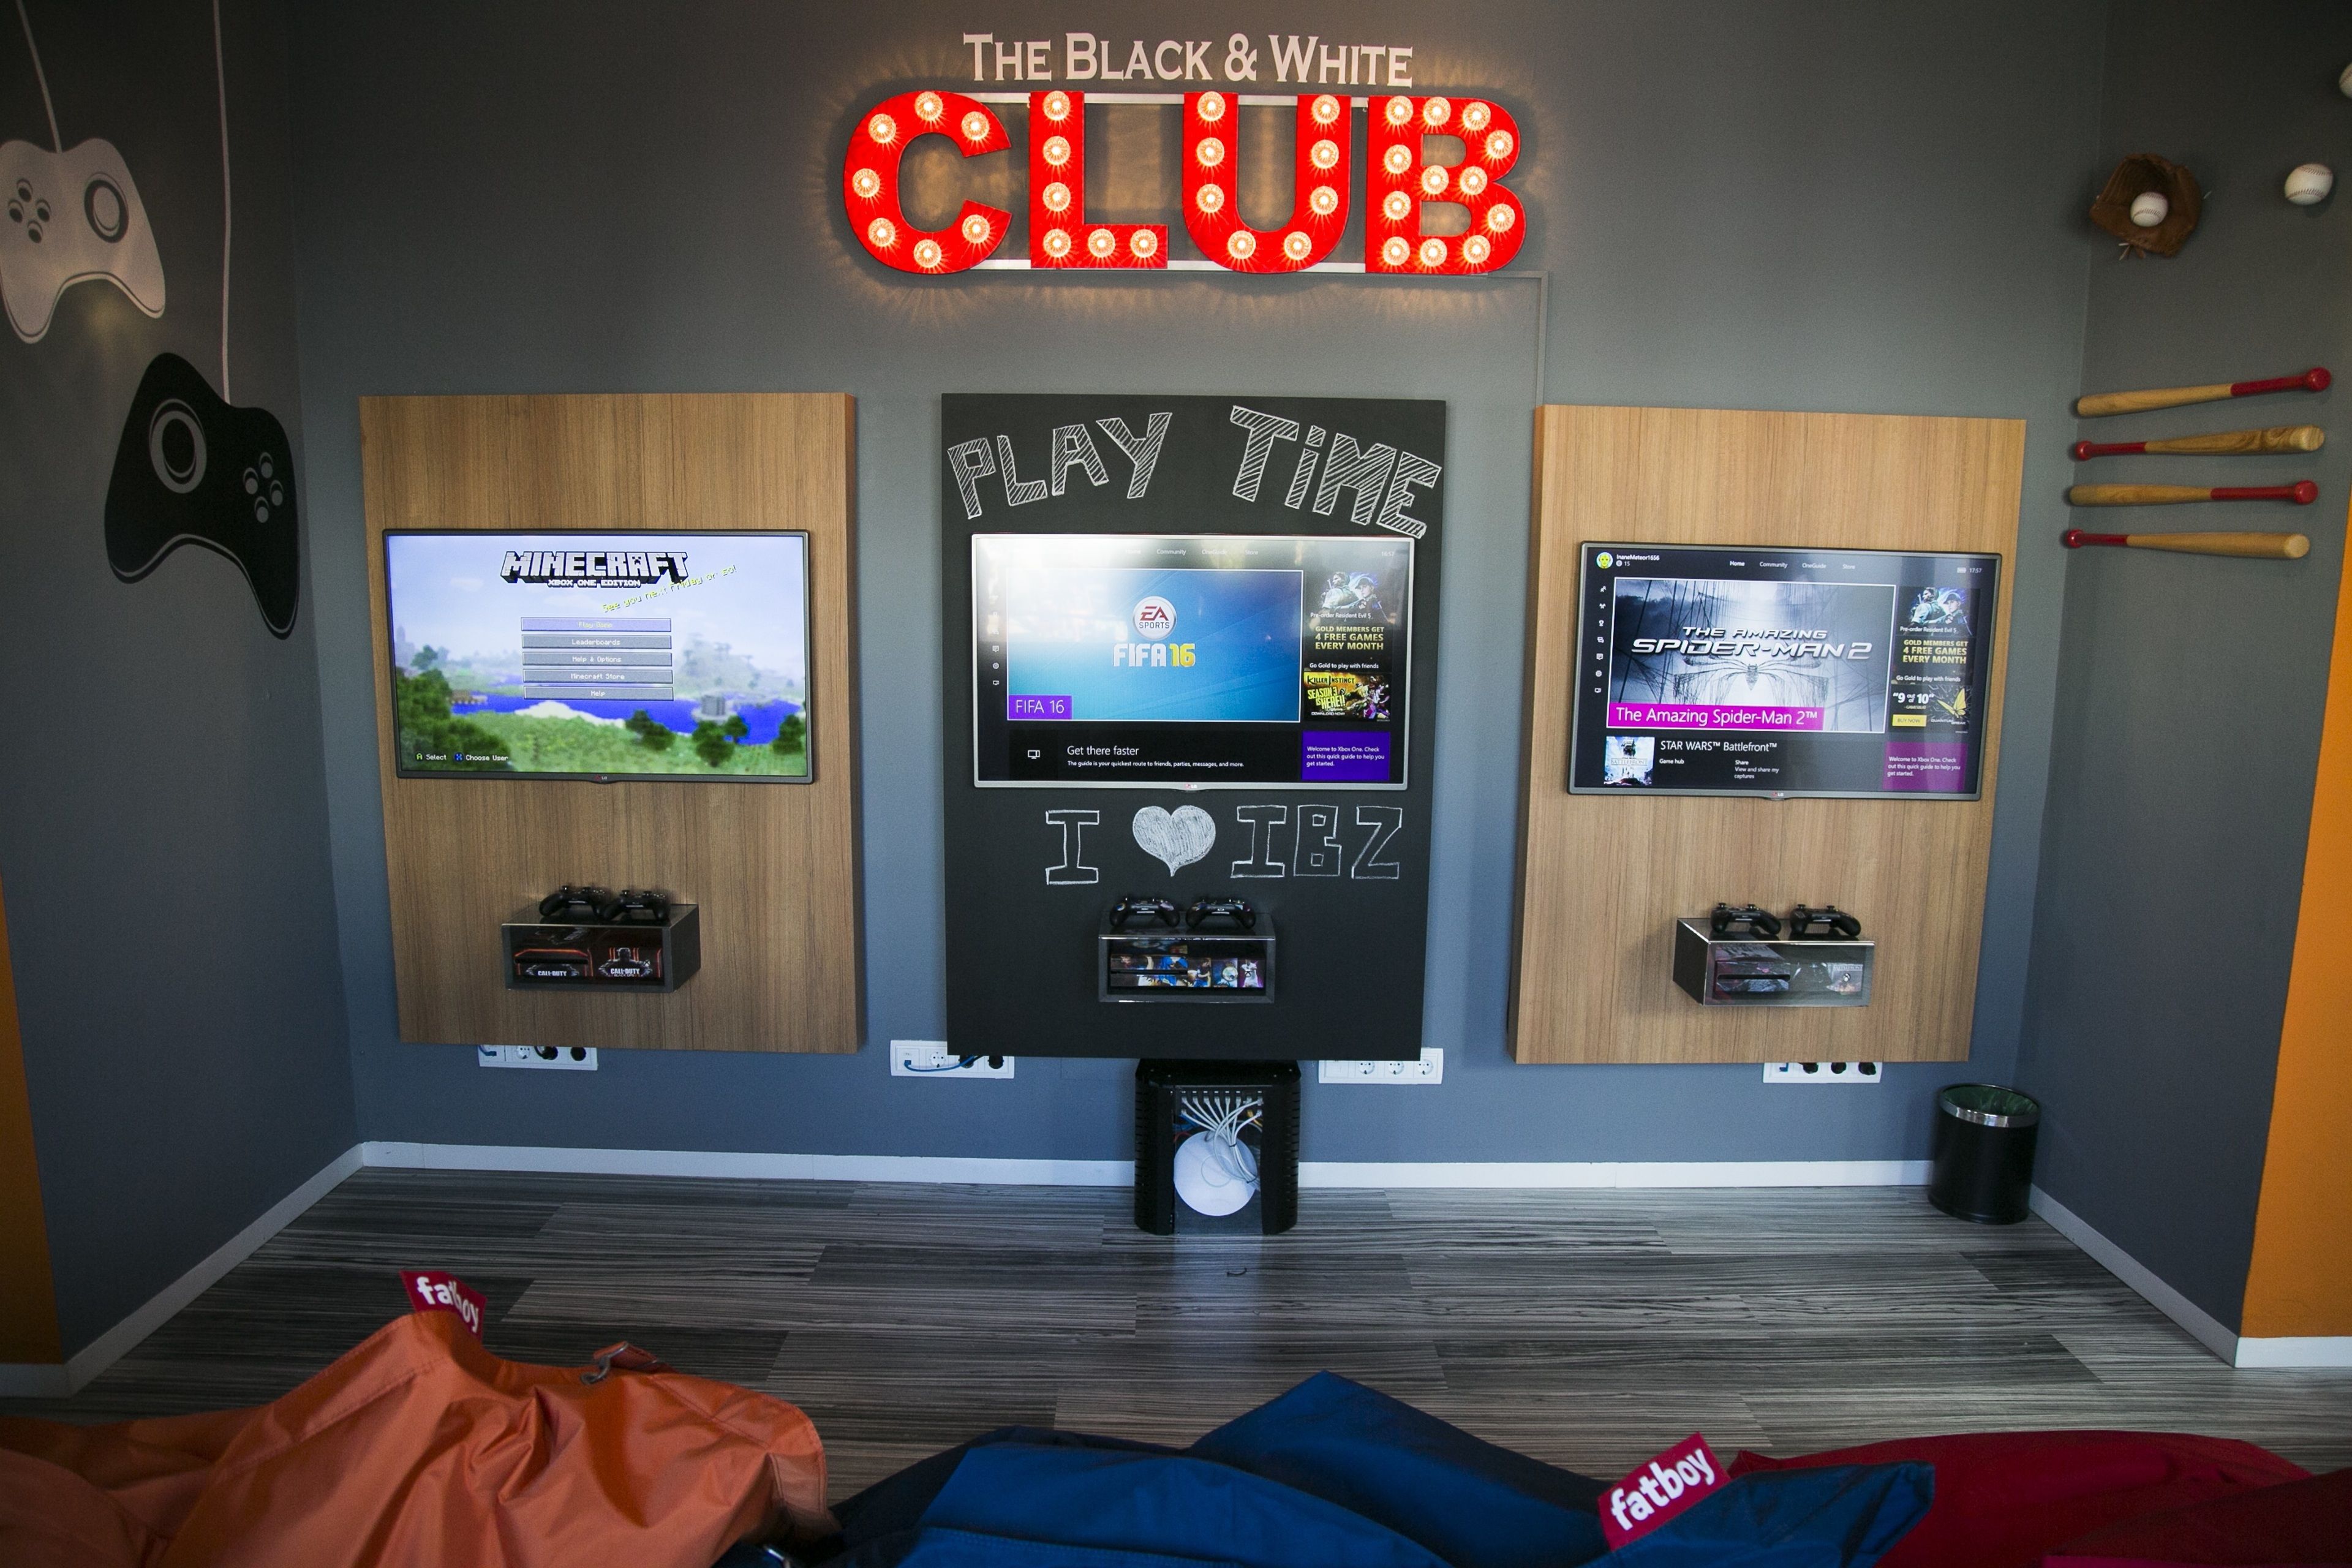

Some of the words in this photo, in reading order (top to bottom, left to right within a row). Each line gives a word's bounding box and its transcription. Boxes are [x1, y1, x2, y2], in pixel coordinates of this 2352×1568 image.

[1226, 33, 1257, 80] &
[843, 90, 1526, 275] CLUB
[947, 412, 1173, 519] PLAY
[500, 551, 688, 583] MINECRAFT
[547, 579, 575, 588] XBOX
[578, 579, 598, 588] ONE
[600, 579, 641, 588] EDITION
[602, 601, 621, 612] See
[624, 596, 643, 608] you
[1139, 606, 1169, 622] EA
[1139, 621, 1170, 630] SPORTS
[1682, 626, 1725, 638] THE
[1732, 628, 1828, 640] AMAZING
[1349, 633, 1384, 642] GAMES
[1347, 642, 1384, 650] MONTH
[1630, 638, 1845, 659] SPIDER-MAN
[1845, 641, 1873, 661] 2
[1113, 643, 1167, 668] FIFA
[1169, 643, 1196, 668] 16
[1932, 655, 1966, 664] MONTH
[1307, 675, 1328, 685] KILLER
[1307, 687, 1332, 699] SEASON
[1332, 686, 1338, 696] 3
[1015, 699, 1045, 714] FIFA
[1049, 699, 1065, 714] 16
[1616, 707, 1643, 723] The
[1646, 707, 1708, 727] Amazing
[1712, 709, 1793, 727] Spider-Man
[1067, 745, 1084, 755] Get
[1087, 745, 1110, 755] there
[1114, 745, 1139, 755] faster
[1660, 741, 1683, 750] STAR
[1045, 809, 1100, 886] I
[1230, 804, 1403, 880] IBZ
[1610, 1448, 1715, 1531] fatboy
